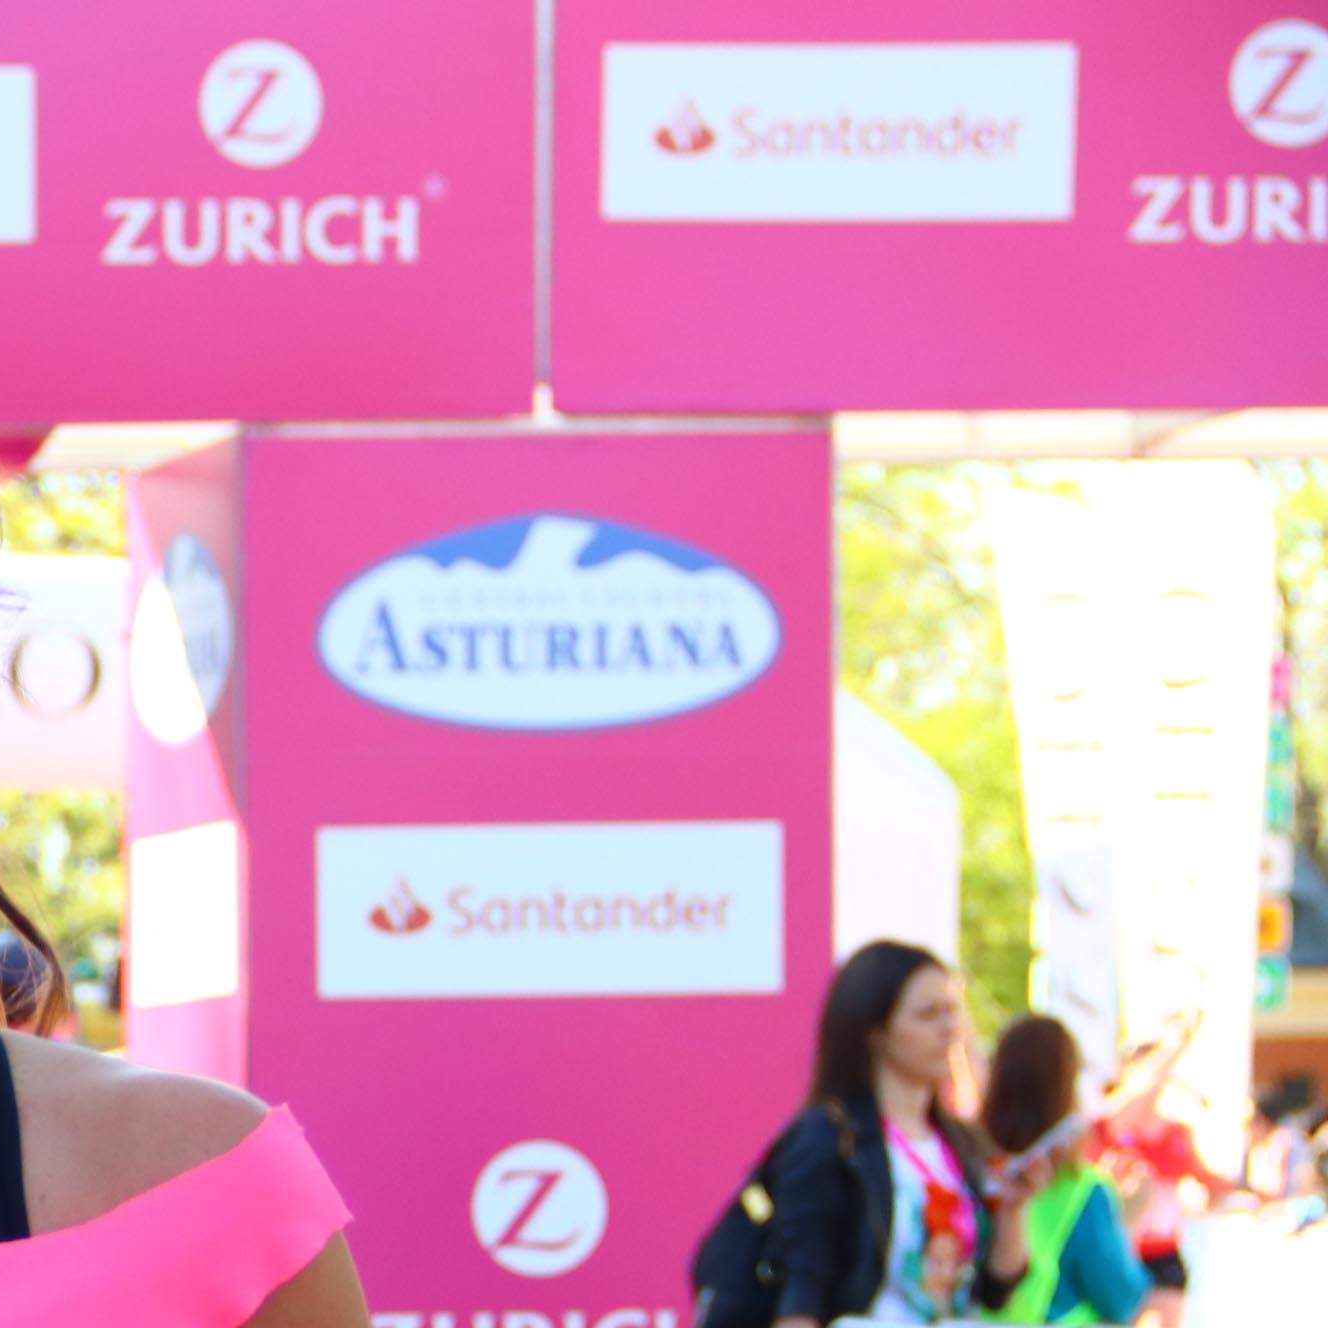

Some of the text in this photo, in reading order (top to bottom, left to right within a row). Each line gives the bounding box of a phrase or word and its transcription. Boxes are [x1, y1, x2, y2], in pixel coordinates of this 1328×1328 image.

[731, 110, 1024, 159] Santander
[100, 194, 420, 266] ZURICH
[355, 599, 742, 674] ASTURIANA
[447, 880, 730, 937] Santander
